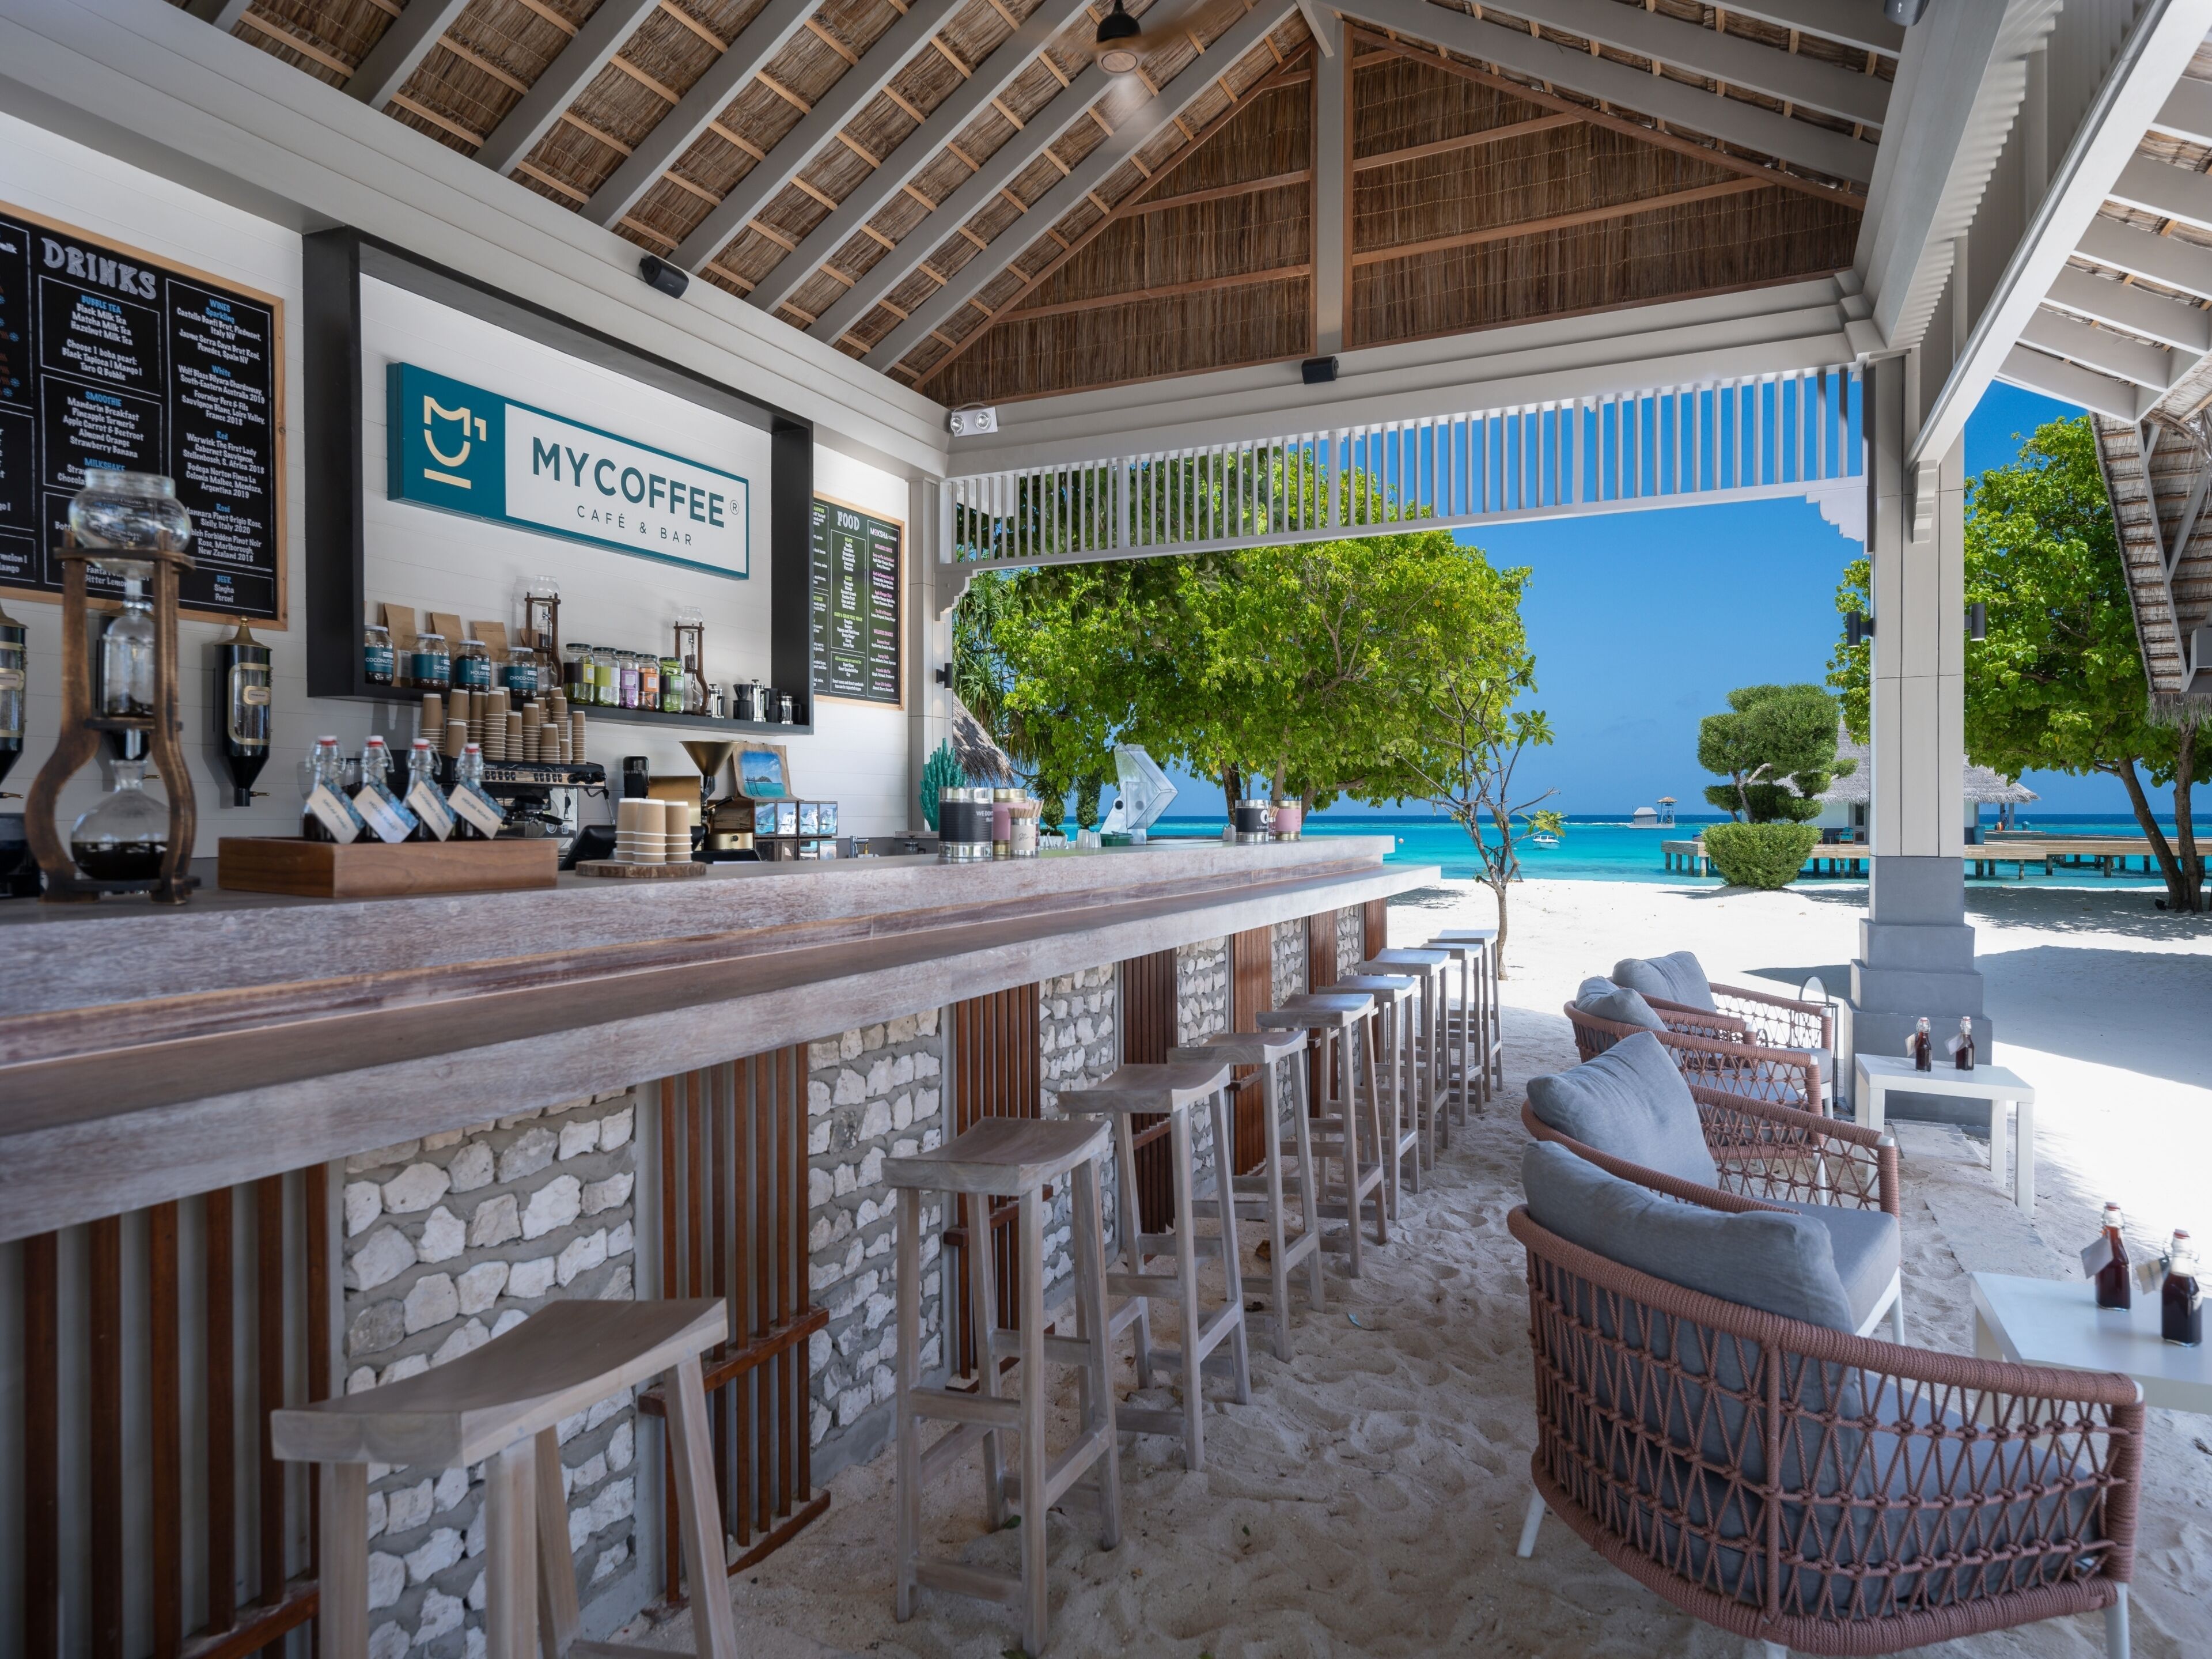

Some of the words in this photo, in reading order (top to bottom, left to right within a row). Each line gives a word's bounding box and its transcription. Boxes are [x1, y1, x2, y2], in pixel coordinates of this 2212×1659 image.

[41, 237, 157, 300] DRINKS
[76, 302, 96, 316] Black
[97, 309, 115, 321] Milk
[115, 315, 127, 325] Tea
[81, 295, 107, 309] BUBBLE
[108, 304, 122, 315] TEA
[209, 298, 231, 313] WINES
[72, 311, 101, 327] Matcha
[102, 320, 119, 332] Milk
[120, 326, 131, 336] Tea
[176, 307, 201, 322] Castello
[202, 315, 218, 327] Banfi
[206, 306, 235, 324] Sparkling
[70, 320, 103, 336] Hazelnut
[104, 331, 121, 342] Milk
[122, 335, 133, 346] Tea
[179, 328, 198, 341] Jaume
[198, 335, 217, 346] Serra
[217, 340, 232, 351] Cava
[232, 344, 245, 355] Brut
[210, 326, 226, 339] Italy
[226, 332, 236, 341] NV
[66, 338, 92, 353] Choose
[99, 348, 116, 359] boba
[222, 350, 239, 362] Spain
[239, 356, 249, 365] NV
[62, 347, 82, 359] Black
[83, 353, 108, 367] Tapioca
[113, 361, 138, 374] Mango
[80, 362, 96, 373] Taro
[97, 366, 104, 376] Q
[104, 368, 126, 381] Bubble
[177, 364, 194, 376] Wolf
[194, 369, 209, 380] Blass
[211, 365, 231, 377] White
[180, 374, 223, 392] South-Eastern
[223, 387, 249, 400] Australia
[249, 394, 265, 404] 2019
[85, 391, 122, 407] SMOOTHIE
[181, 395, 214, 410] Sauvignon
[232, 408, 247, 419] Loire
[194, 389, 219, 403] Fournier
[219, 396, 233, 407] Pere
[238, 402, 249, 412] Fils
[67, 396, 104, 412] Mandarin
[104, 406, 139, 421] Breakfast
[206, 410, 226, 422] France
[72, 407, 105, 423] Pineapple
[105, 416, 135, 429] Turmeric
[62, 415, 82, 426] Apple
[83, 420, 107, 432] Carrot
[114, 426, 144, 441] Beetroot
[216, 431, 229, 441] Red
[70, 435, 112, 453] Strawberry
[112, 445, 138, 458] Banana
[78, 429, 104, 441] Almond
[105, 434, 130, 447] Orange
[186, 433, 216, 447] Warwick
[216, 440, 228, 449] The
[228, 443, 243, 453] First
[243, 446, 257, 457] Lady
[195, 444, 223, 457] Cabernet
[84, 457, 125, 471] MILKSHAKE
[187, 462, 210, 475] Bodega
[210, 467, 232, 479] Norton
[232, 472, 248, 482] Finca
[248, 475, 256, 484] La
[229, 460, 248, 471] Africa
[57, 472, 86, 485] Chocola
[185, 471, 209, 482] Colonia
[533, 436, 724, 528] MYCOFFEE
[200, 482, 233, 496] Argentina
[233, 489, 249, 499] 2019
[215, 503, 230, 513] Rosé
[212, 512, 229, 522] Pinot
[229, 515, 247, 525] Grigio
[218, 521, 234, 532] Italy
[234, 525, 251, 534] 2020
[577, 505, 626, 529] CAFÉ
[639, 522, 647, 535] &
[661, 527, 692, 547] BAR
[837, 511, 860, 531] FOOD
[204, 530, 232, 542] Forbidden
[232, 536, 249, 544] Pinot
[249, 539, 262, 547] Noir
[198, 547, 213, 556] New
[213, 549, 237, 560] Zealand
[86, 565, 107, 575] Fanta
[217, 575, 232, 584] BEER
[214, 584, 234, 594] Singha
[215, 593, 234, 603] Peroni
